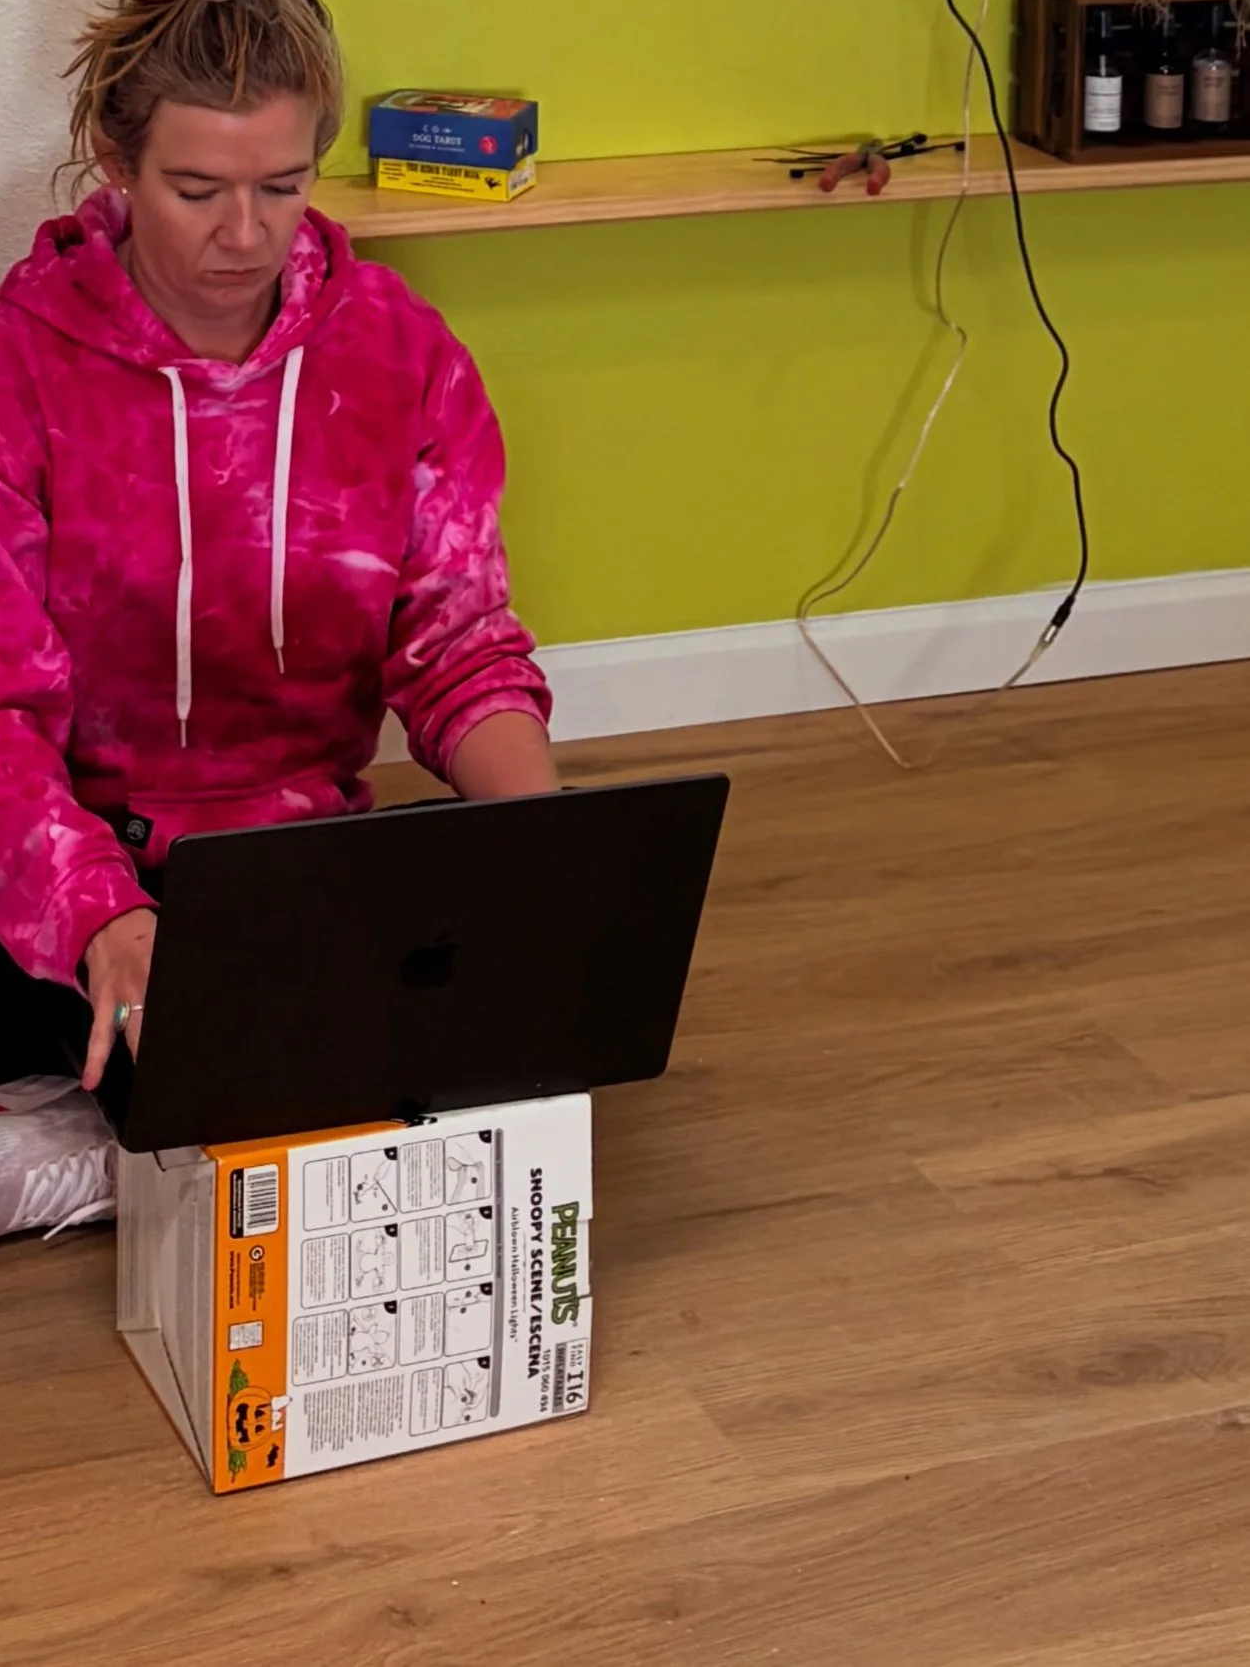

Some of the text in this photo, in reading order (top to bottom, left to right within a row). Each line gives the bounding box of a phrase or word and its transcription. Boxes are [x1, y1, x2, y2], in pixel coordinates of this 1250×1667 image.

[412, 133, 463, 146] DOG TAROT
[510, 1206, 520, 1253] Airblown
[510, 1254, 520, 1308] Halloween
[527, 1167, 543, 1379] SNOOPY SCENE/ESCENA
[551, 1201, 579, 1325] PEANUTS
[566, 1370, 584, 1404] I16
